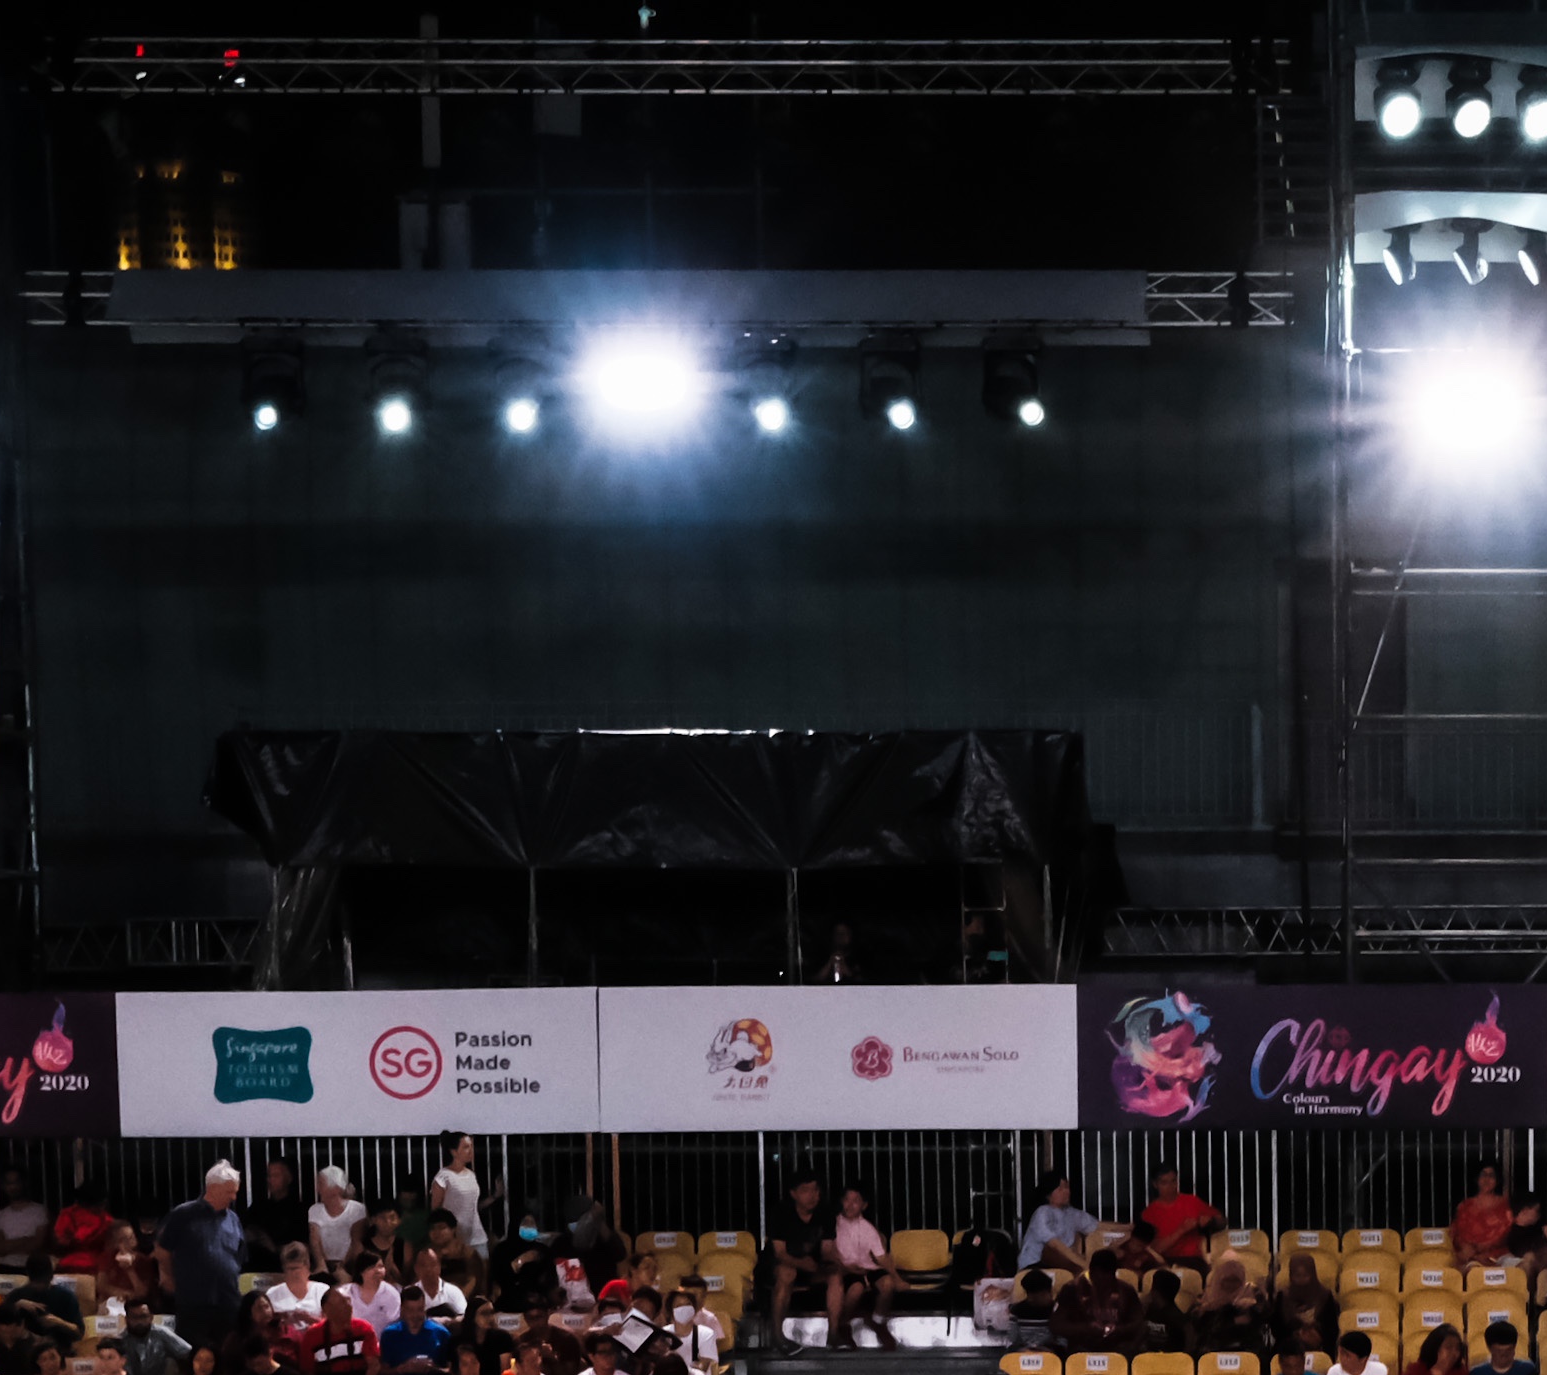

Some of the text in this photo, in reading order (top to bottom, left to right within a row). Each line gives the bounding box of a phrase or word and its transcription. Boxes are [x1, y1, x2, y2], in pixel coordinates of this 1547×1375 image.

[455, 1030, 532, 1047] Passion
[226, 1037, 298, 1062] Singapore
[903, 1046, 1019, 1062] BENGAWAN SOLO
[229, 1063, 299, 1075] TOURISM
[380, 1047, 433, 1078] SG
[455, 1054, 511, 1071] Made
[1251, 1018, 1521, 1118] Chingay 2020
[40, 1074, 90, 1091] 2020
[236, 1077, 291, 1088] BOARD
[456, 1077, 541, 1094] Possible
[1282, 1093, 1330, 1104] Colours
[1294, 1104, 1363, 1116] in Harmony
